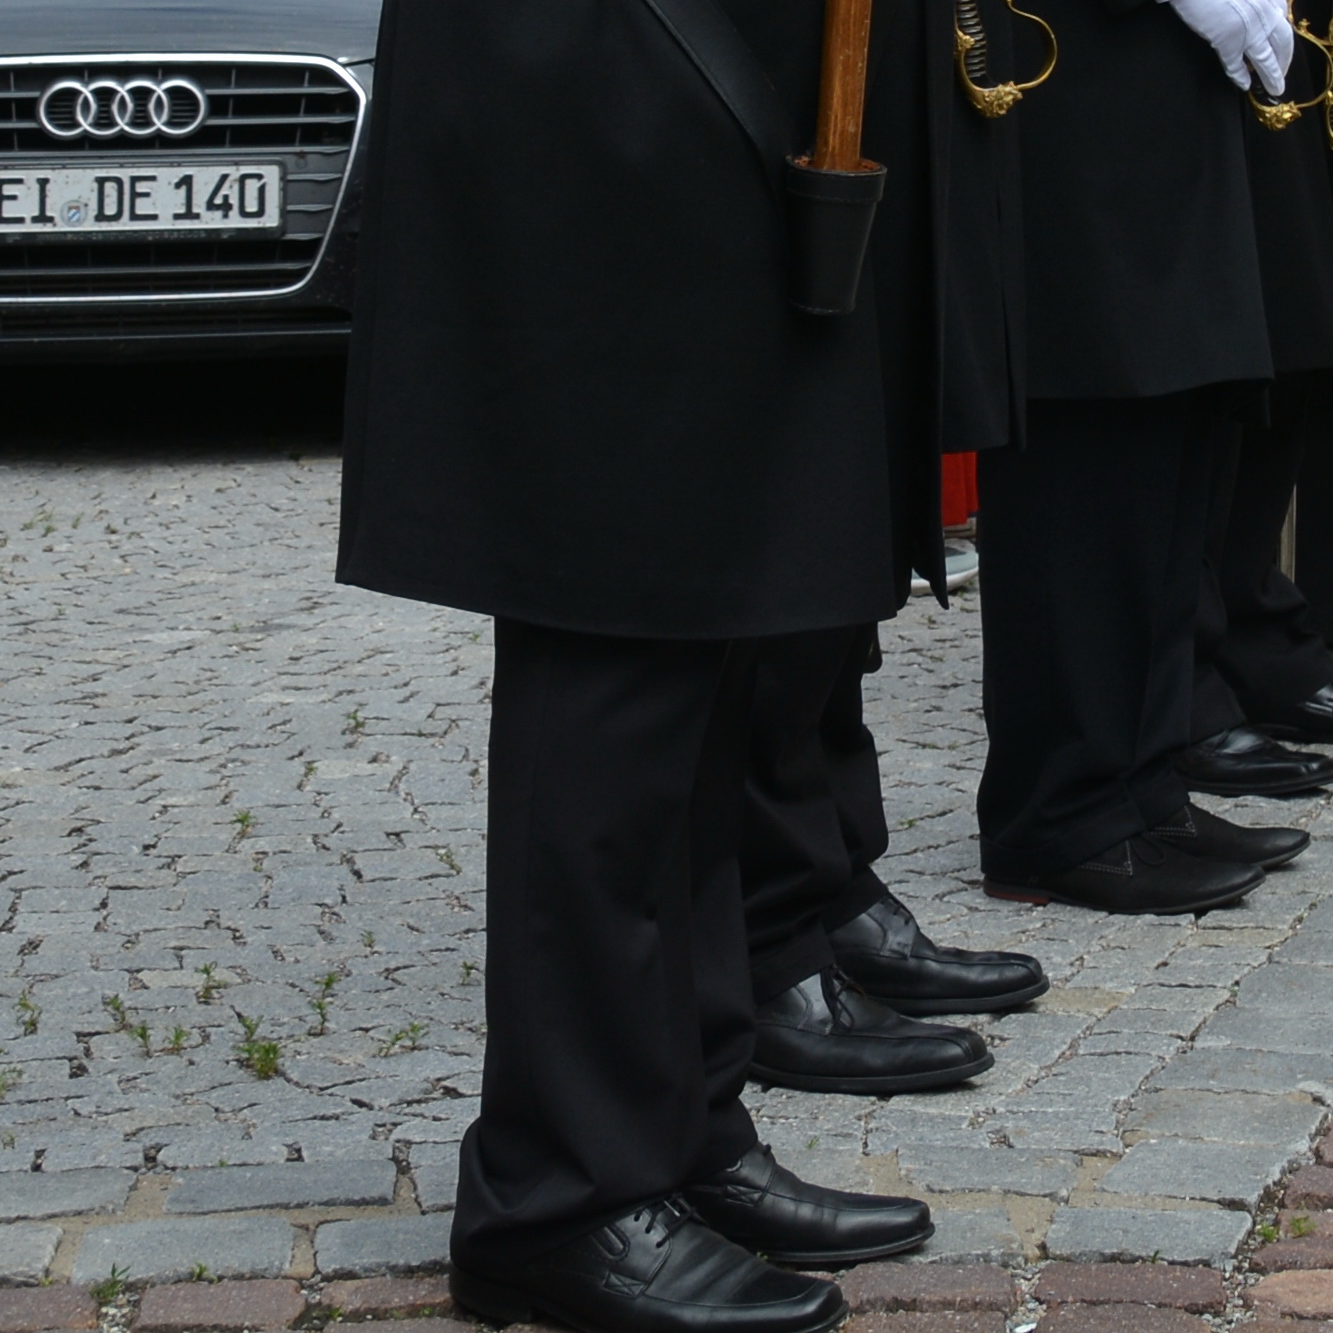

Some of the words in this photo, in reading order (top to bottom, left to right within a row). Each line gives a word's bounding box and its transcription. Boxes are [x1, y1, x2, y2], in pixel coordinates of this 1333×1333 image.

[0, 177, 55, 224] EI
[94, 175, 159, 222] DE
[172, 173, 267, 221] 140
